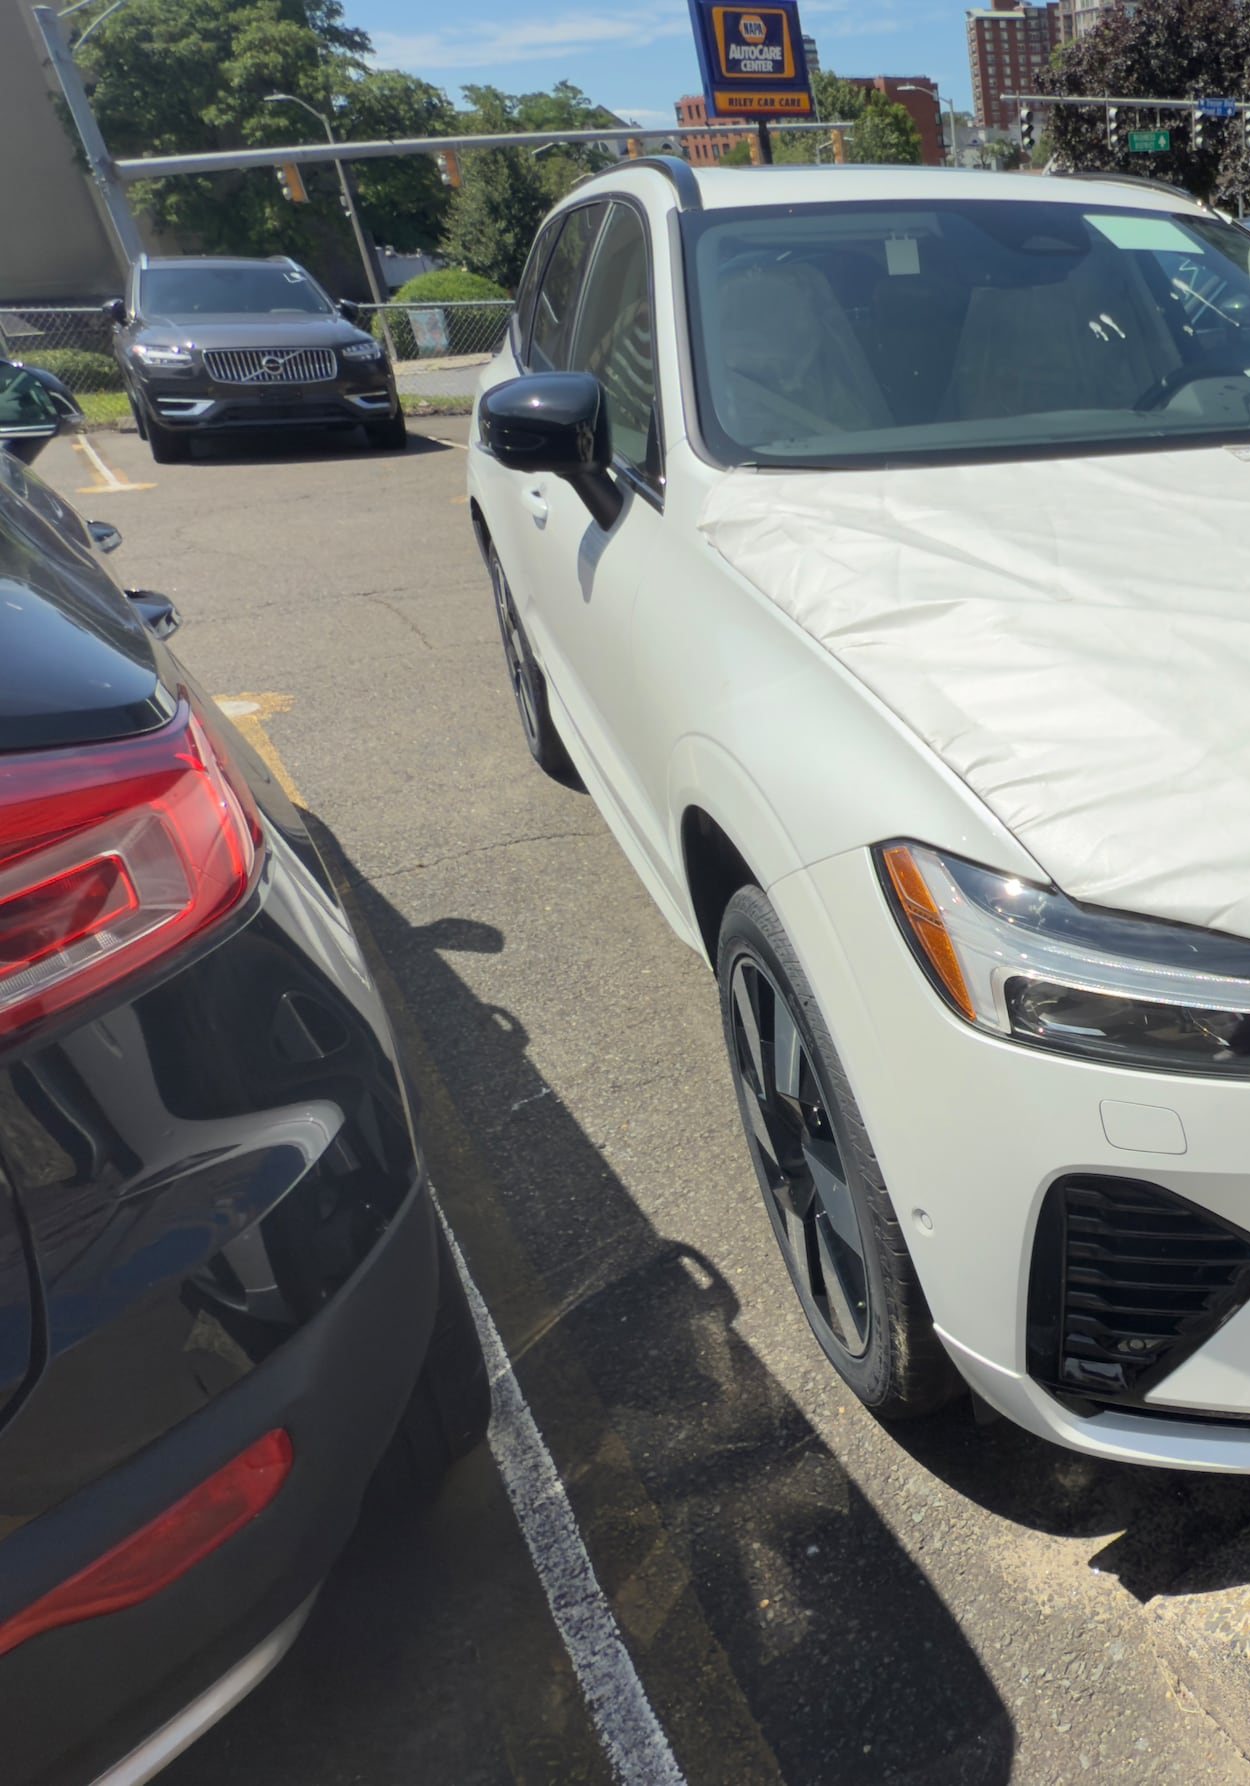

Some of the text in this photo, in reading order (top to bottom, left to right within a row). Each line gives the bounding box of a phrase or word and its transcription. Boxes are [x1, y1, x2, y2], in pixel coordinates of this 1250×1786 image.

[743, 22, 763, 36] NAPA
[741, 60, 773, 72] CENTER
[728, 97, 801, 107] RILEY CAR CARE
